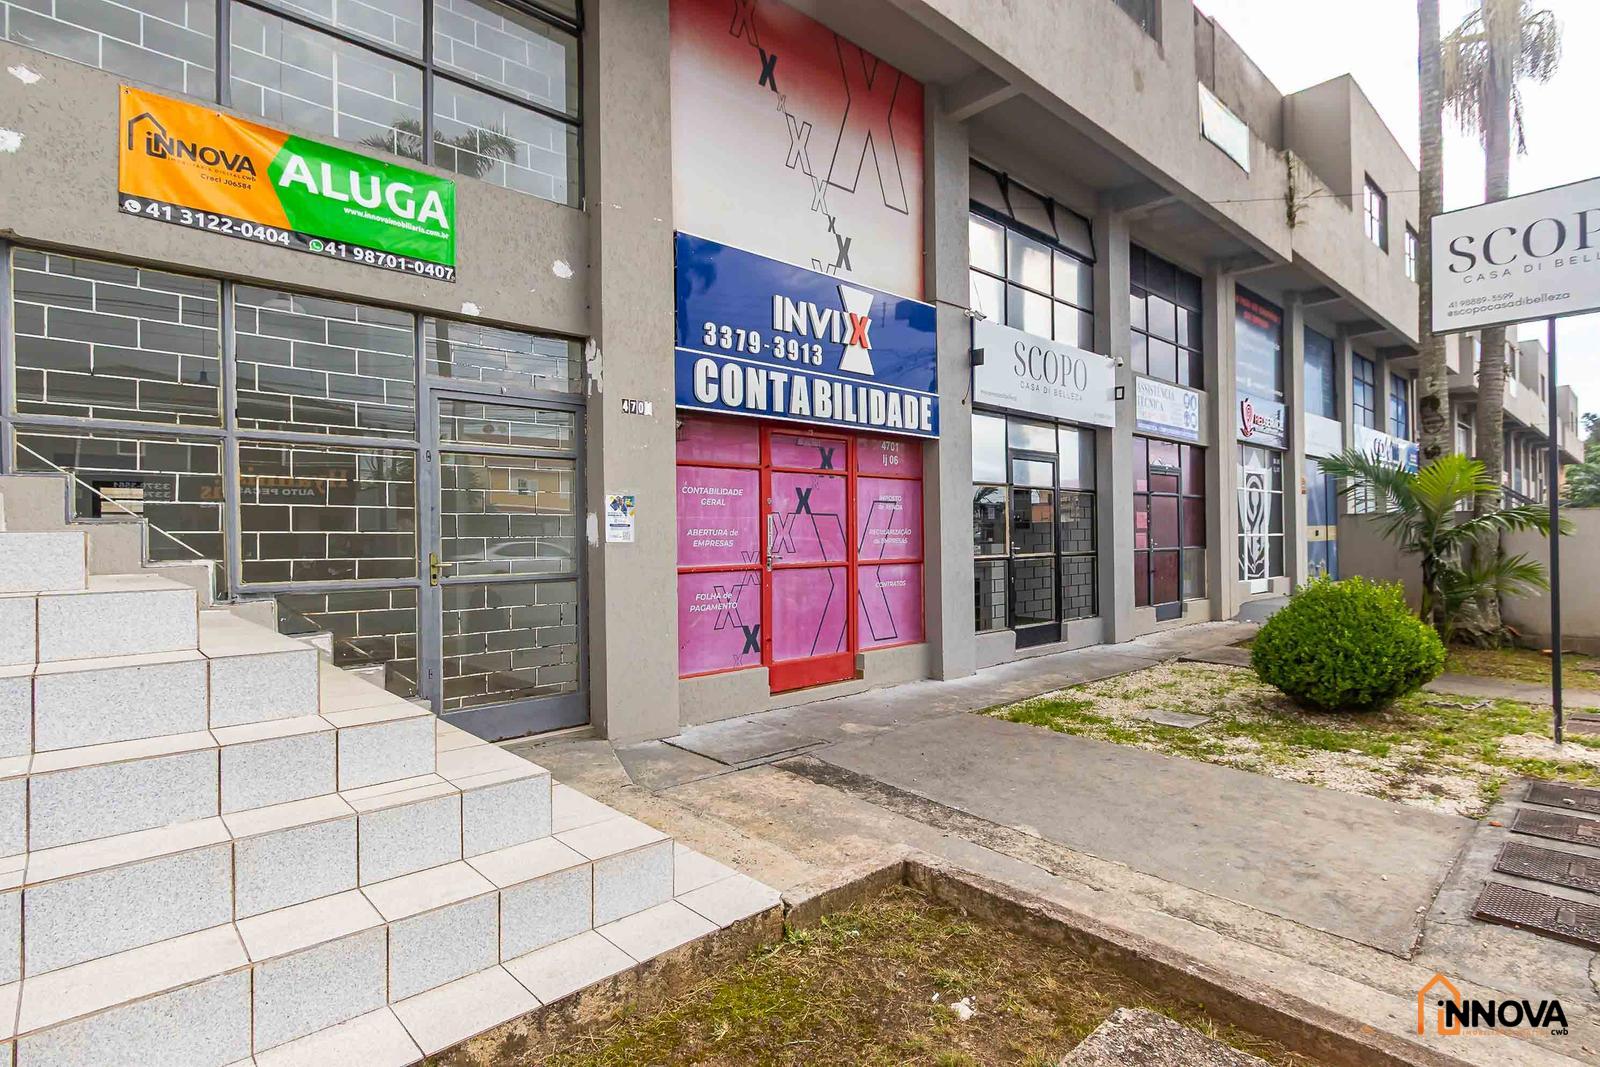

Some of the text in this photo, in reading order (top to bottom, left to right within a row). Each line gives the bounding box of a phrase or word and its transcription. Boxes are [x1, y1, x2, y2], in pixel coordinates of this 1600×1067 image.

[279, 155, 449, 229] ALUGA
[146, 202, 290, 246] 41 3122-0404
[324, 242, 454, 280] 41 98701-0407
[1463, 268, 1512, 284] CASA
[1523, 262, 1542, 274] DI
[703, 321, 823, 366] 3379-3913
[1014, 340, 1088, 392] SCOPO
[1020, 380, 1040, 391] CASA
[694, 357, 932, 432] CONTABILIDADE
[881, 440, 899, 453] 4701
[889, 455, 899, 465] 06
[681, 486, 744, 496] CONTABILIDADE
[700, 498, 726, 507] GERAL
[687, 528, 739, 537] ABERTURA de
[692, 539, 734, 548] EMPRESAS
[695, 591, 733, 602] FOLHA de
[689, 602, 738, 613] PAGAMENTO
